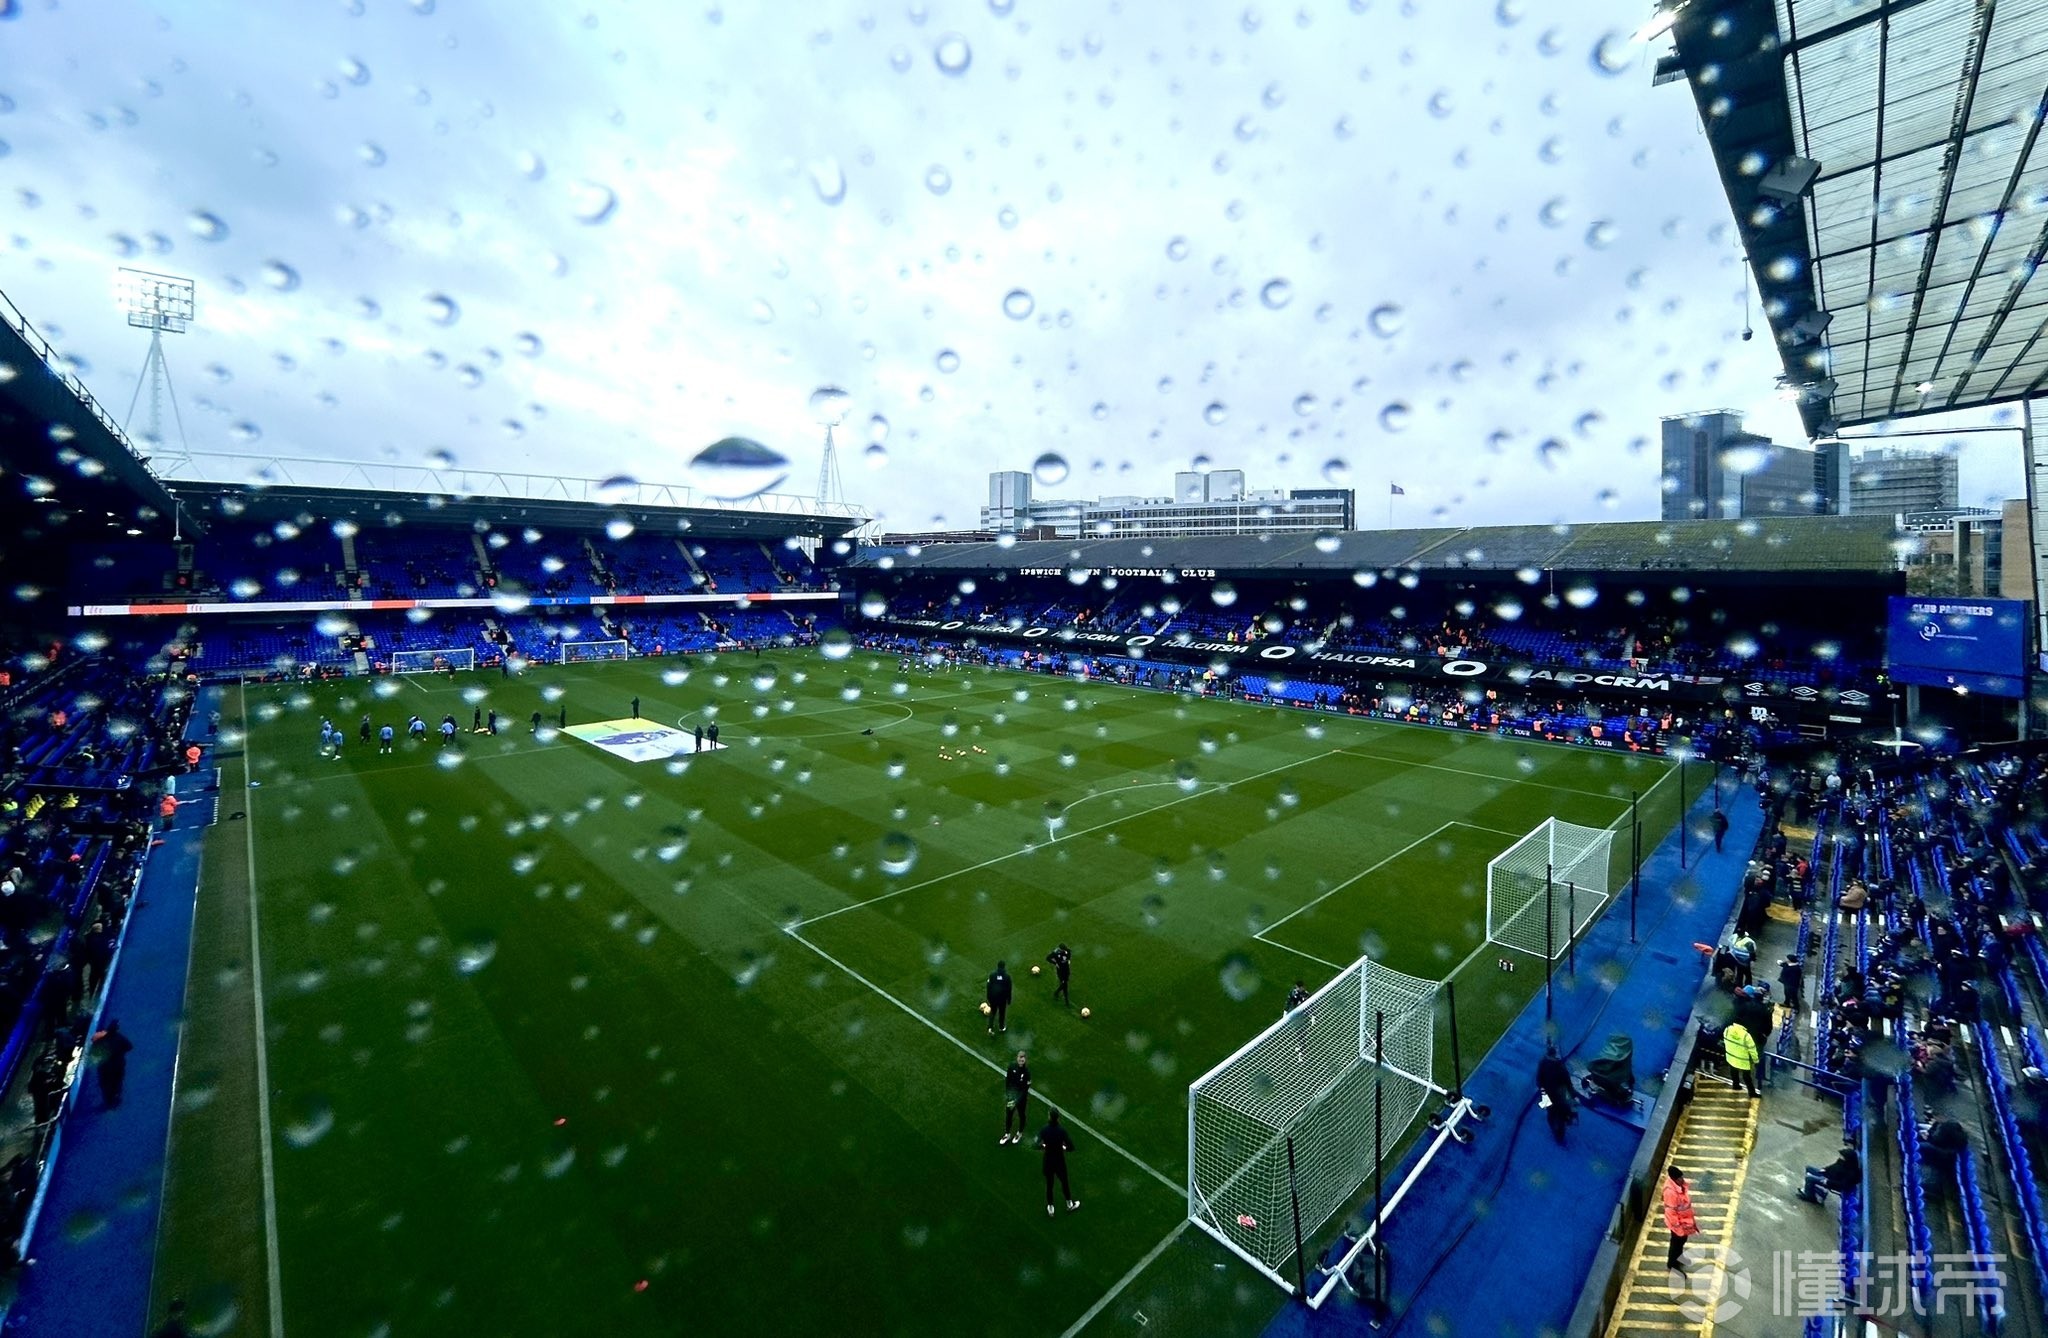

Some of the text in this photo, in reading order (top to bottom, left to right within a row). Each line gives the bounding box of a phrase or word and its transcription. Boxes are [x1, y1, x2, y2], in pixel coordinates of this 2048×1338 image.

[1020, 568, 1062, 576] IPSWICH
[1181, 569, 1216, 577] CLUB
[1912, 604, 1937, 614] CLUB
[1051, 631, 1120, 642] HLOCRM
[1161, 639, 1249, 654] HALOITSM
[1310, 651, 1415, 669] HALOPSA
